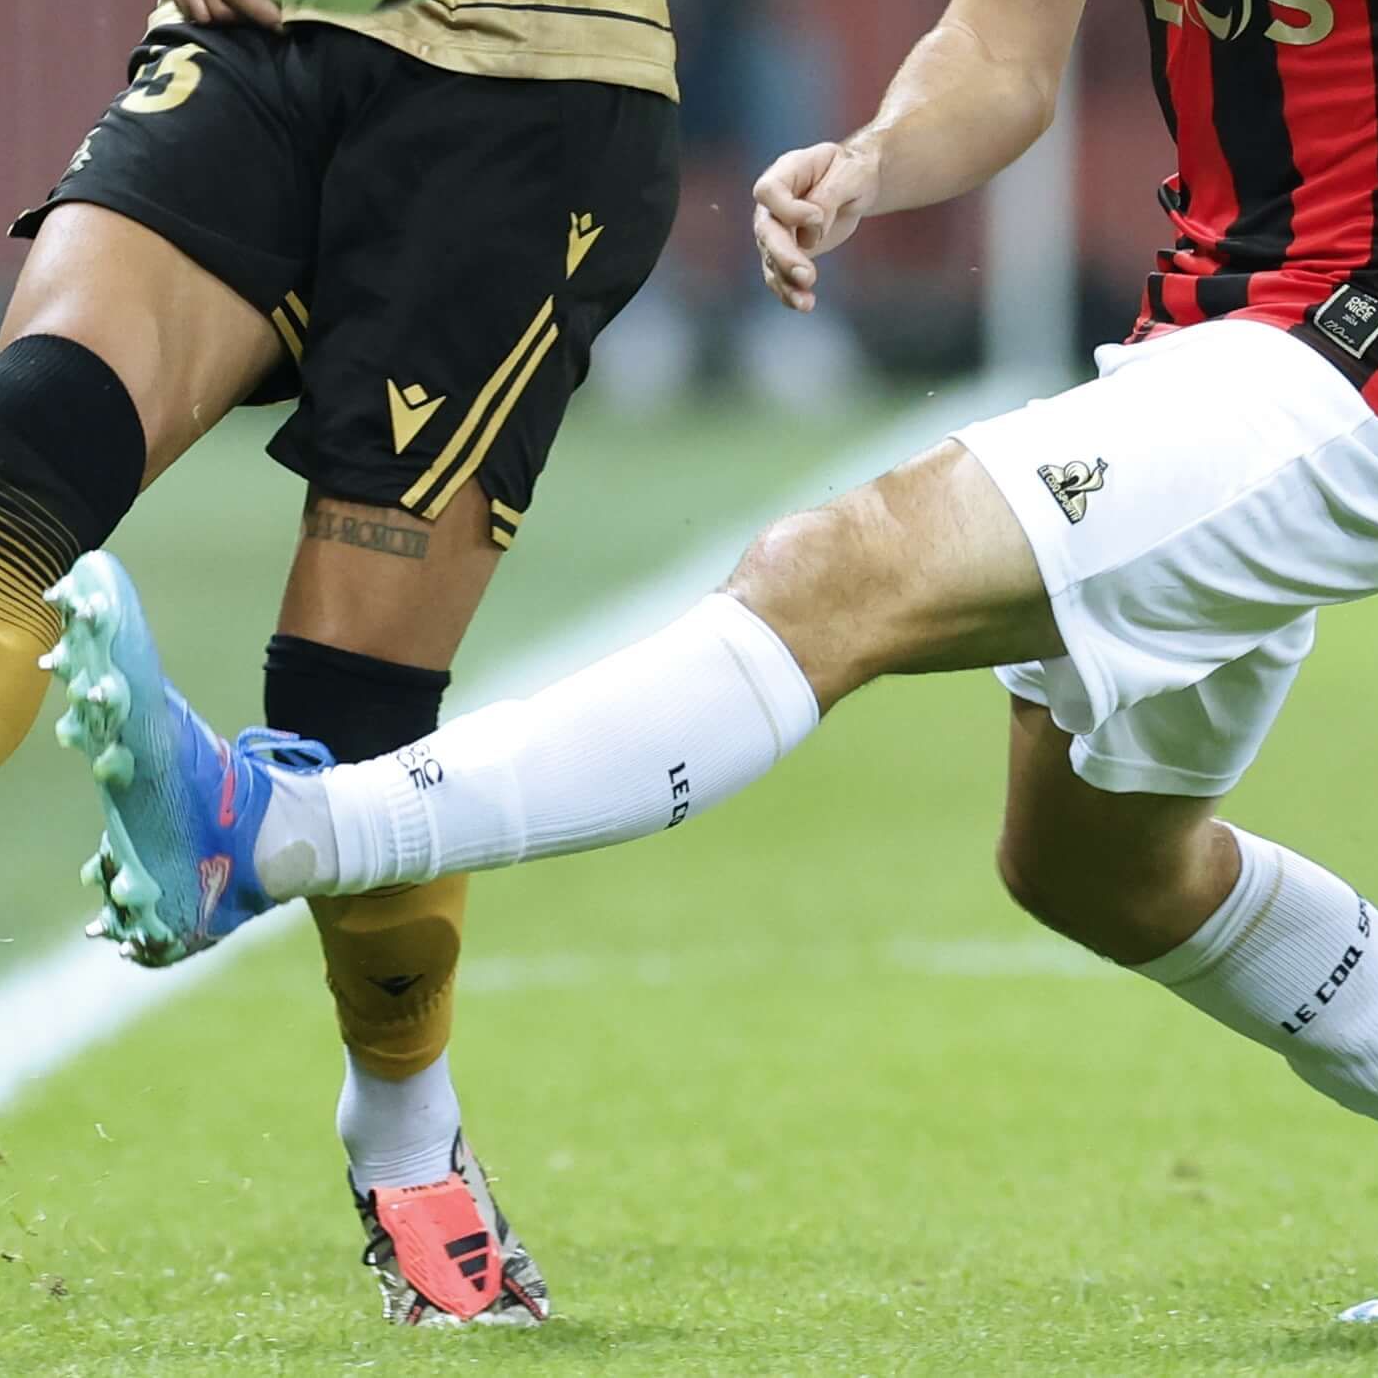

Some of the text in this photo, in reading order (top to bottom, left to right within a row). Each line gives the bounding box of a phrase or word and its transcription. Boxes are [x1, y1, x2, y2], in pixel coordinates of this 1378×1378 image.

[1344, 301, 1374, 322] NICE
[1350, 296, 1377, 314] OGC
[668, 761, 690, 800] LE
[1280, 945, 1364, 1035] LE COQ
